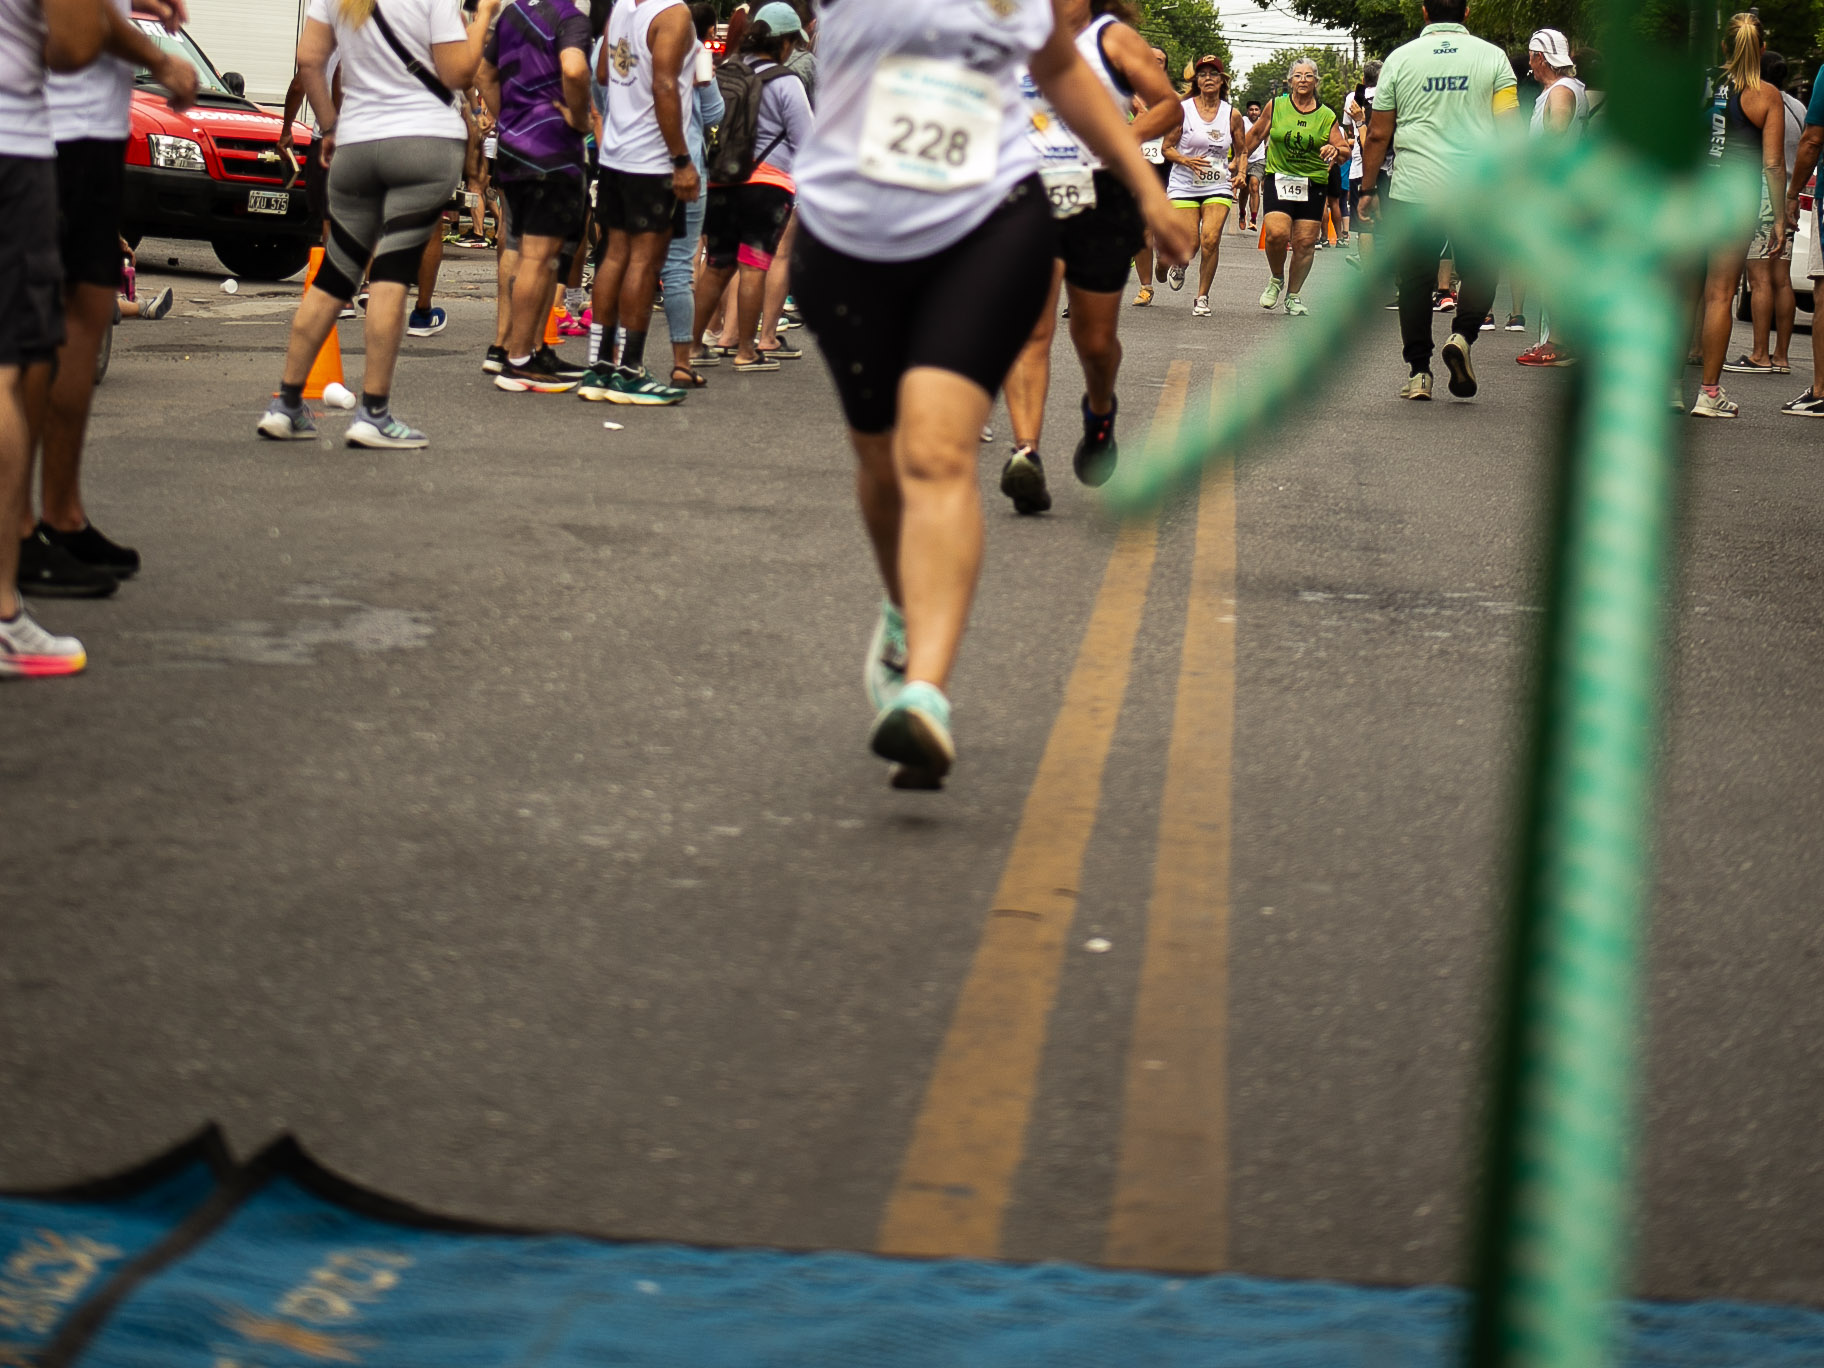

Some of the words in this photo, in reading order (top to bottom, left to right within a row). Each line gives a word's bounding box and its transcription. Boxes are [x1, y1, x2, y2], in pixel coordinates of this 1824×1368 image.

[1422, 76, 1469, 93] JUEZ
[888, 114, 971, 167] 228
[1199, 170, 1221, 181] 586
[1281, 185, 1302, 195] 145
[270, 197, 288, 211] 575
